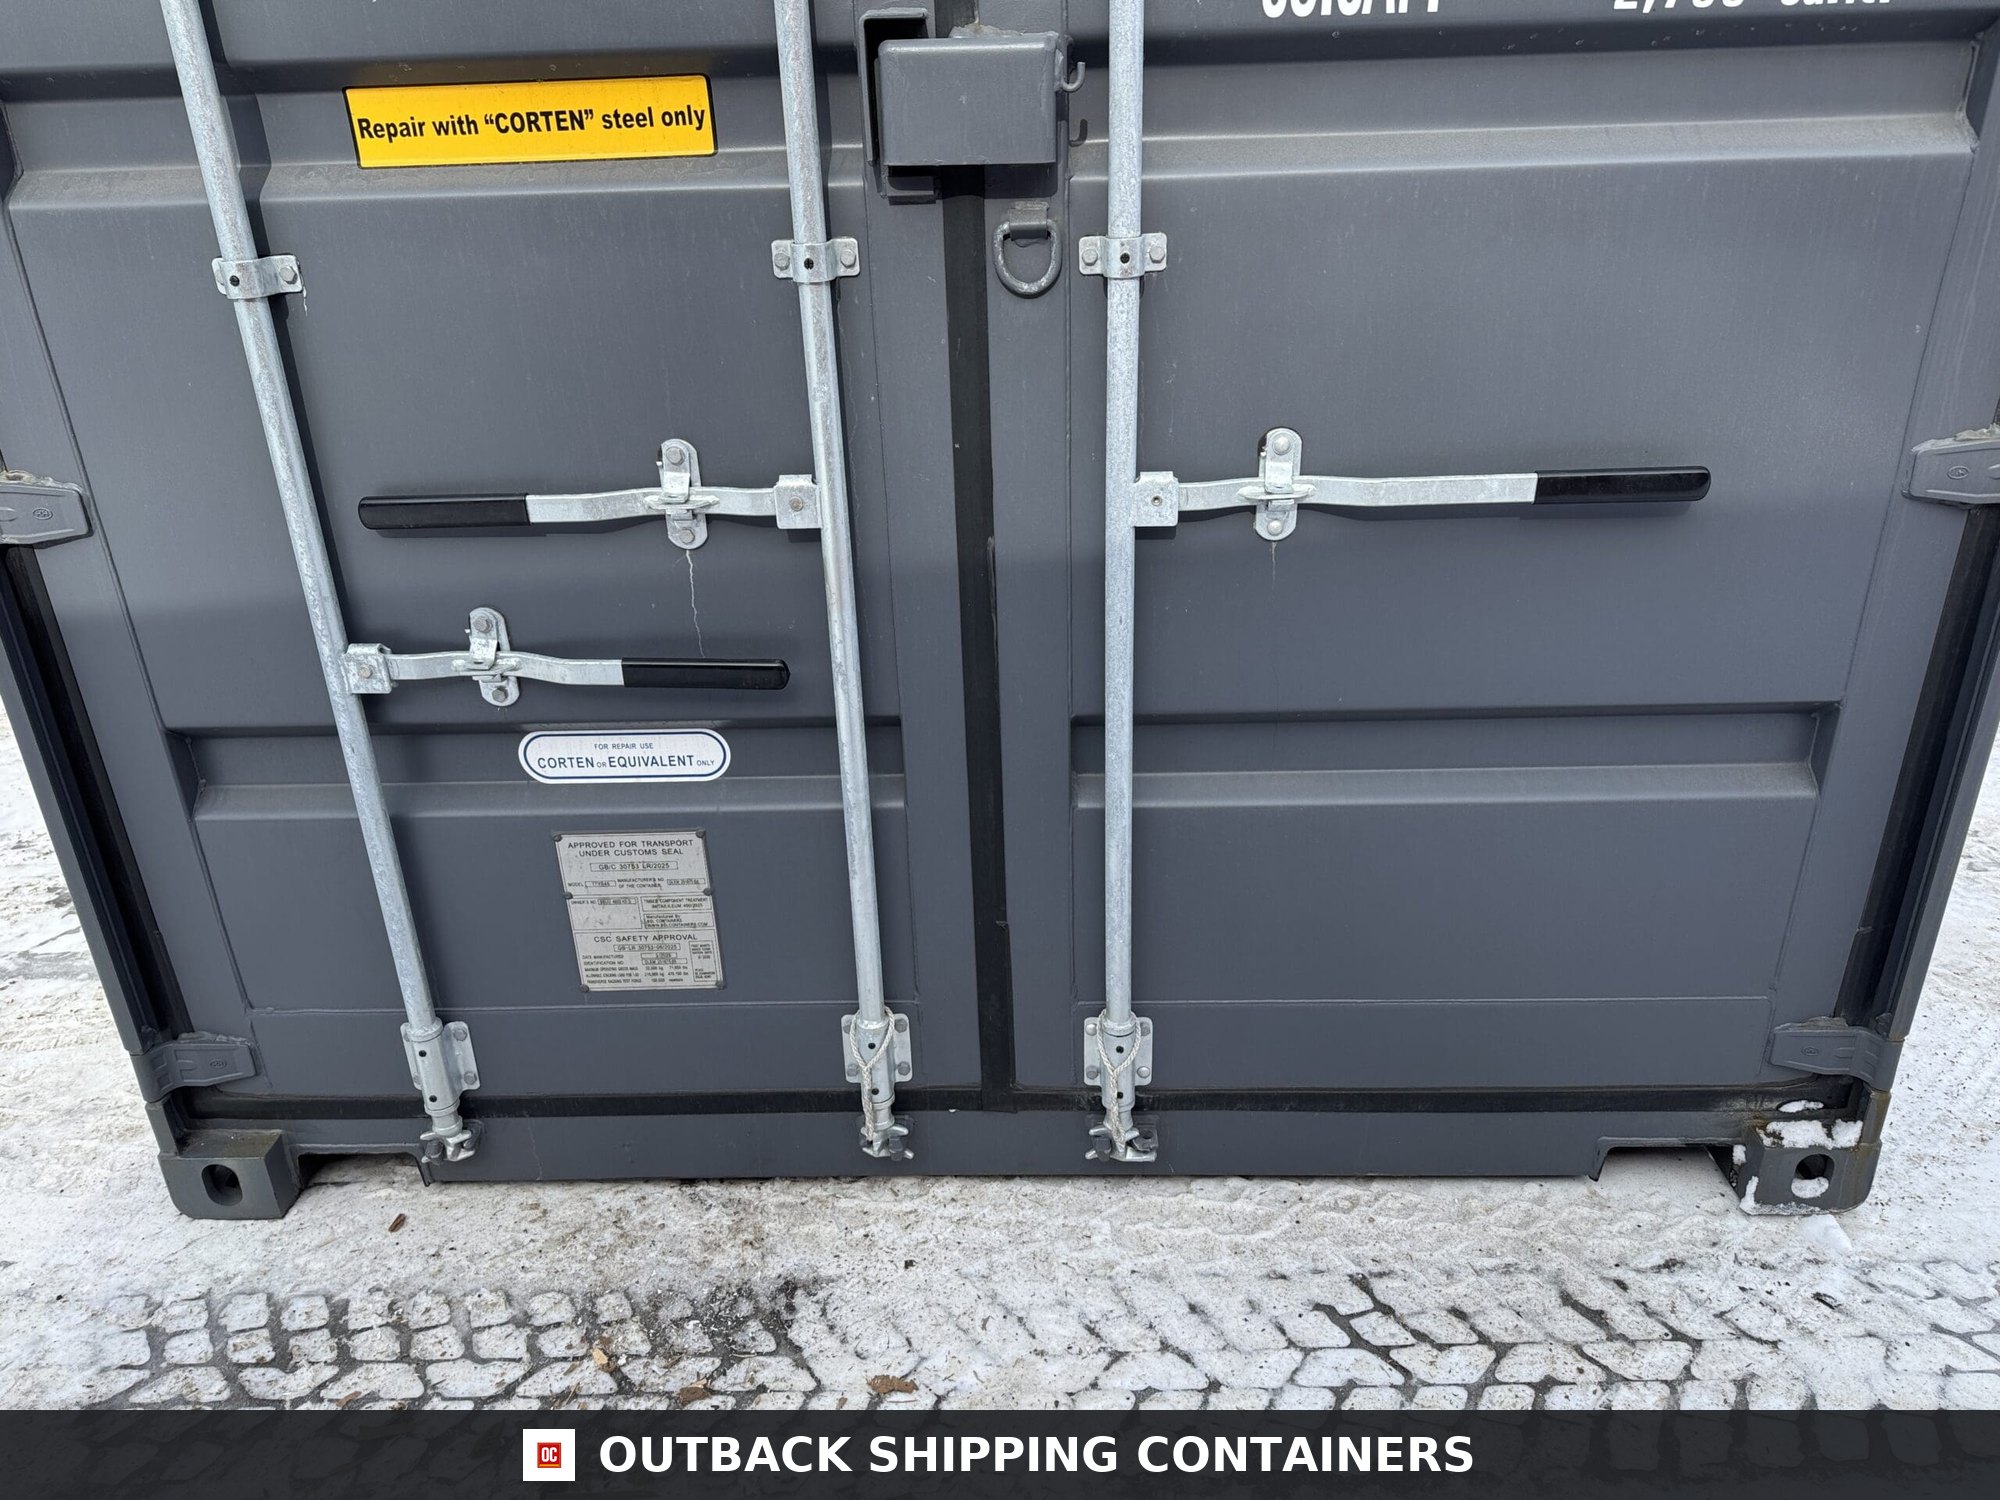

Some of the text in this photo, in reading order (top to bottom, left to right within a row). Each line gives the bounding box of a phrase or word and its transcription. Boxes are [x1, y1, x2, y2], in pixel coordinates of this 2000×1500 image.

[358, 104, 705, 144] Repair with “CORTEN” steel only
[538, 756, 595, 769] CORTEN
[610, 754, 694, 768] EQUIVALENT
